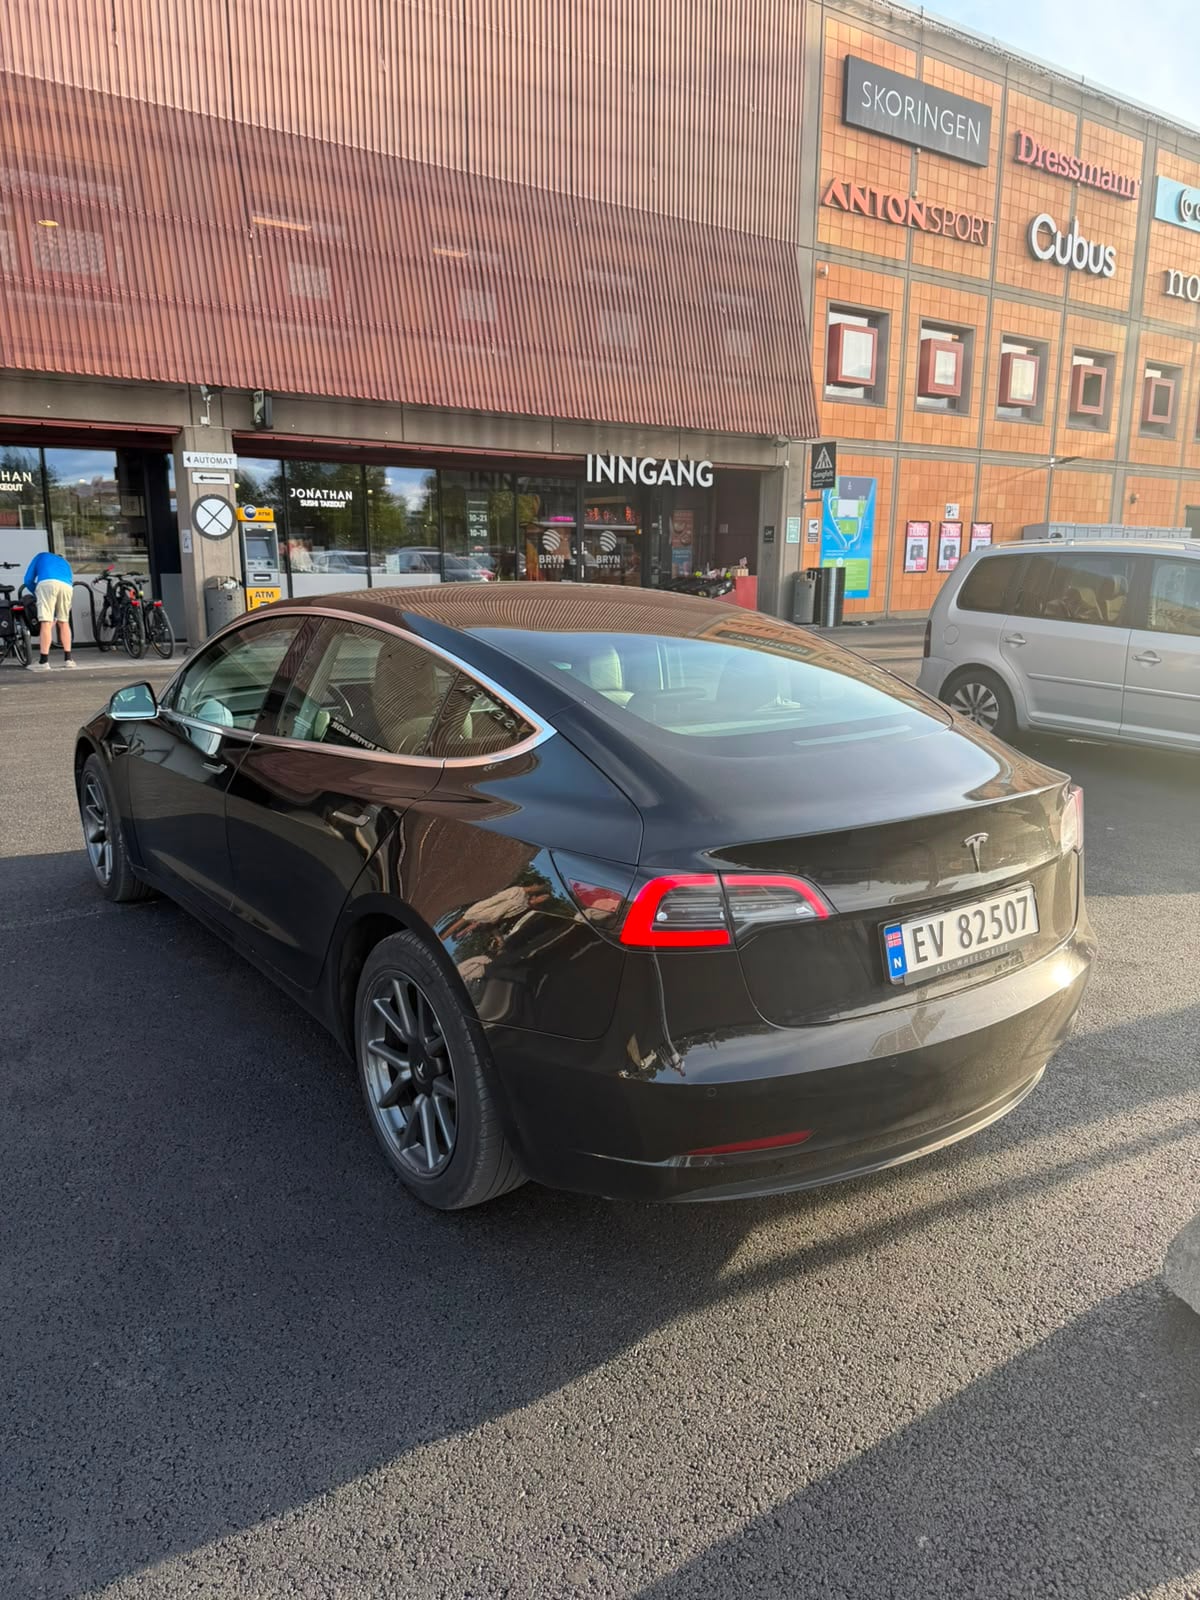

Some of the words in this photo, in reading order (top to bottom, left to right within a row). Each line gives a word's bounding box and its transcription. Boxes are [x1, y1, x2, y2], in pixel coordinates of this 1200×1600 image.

[861, 80, 982, 145] SKORINGEN
[1016, 129, 1140, 200] Dressmann
[1029, 212, 1118, 279] Cubus
[1166, 267, 1200, 303] no
[193, 456, 234, 466] AUTOMAT
[586, 453, 714, 489] INNGANG
[289, 487, 354, 501] JONATHAN
[300, 499, 318, 508] SUSHI
[320, 500, 347, 510] TAKEOUT
[469, 514, 488, 523] 10-21
[538, 554, 565, 564] BRYN
[596, 554, 621, 565] BRYN
[255, 591, 275, 599] ATM
[911, 919, 945, 965] EV
[957, 895, 1029, 951] 82507
[893, 957, 903, 969] N
